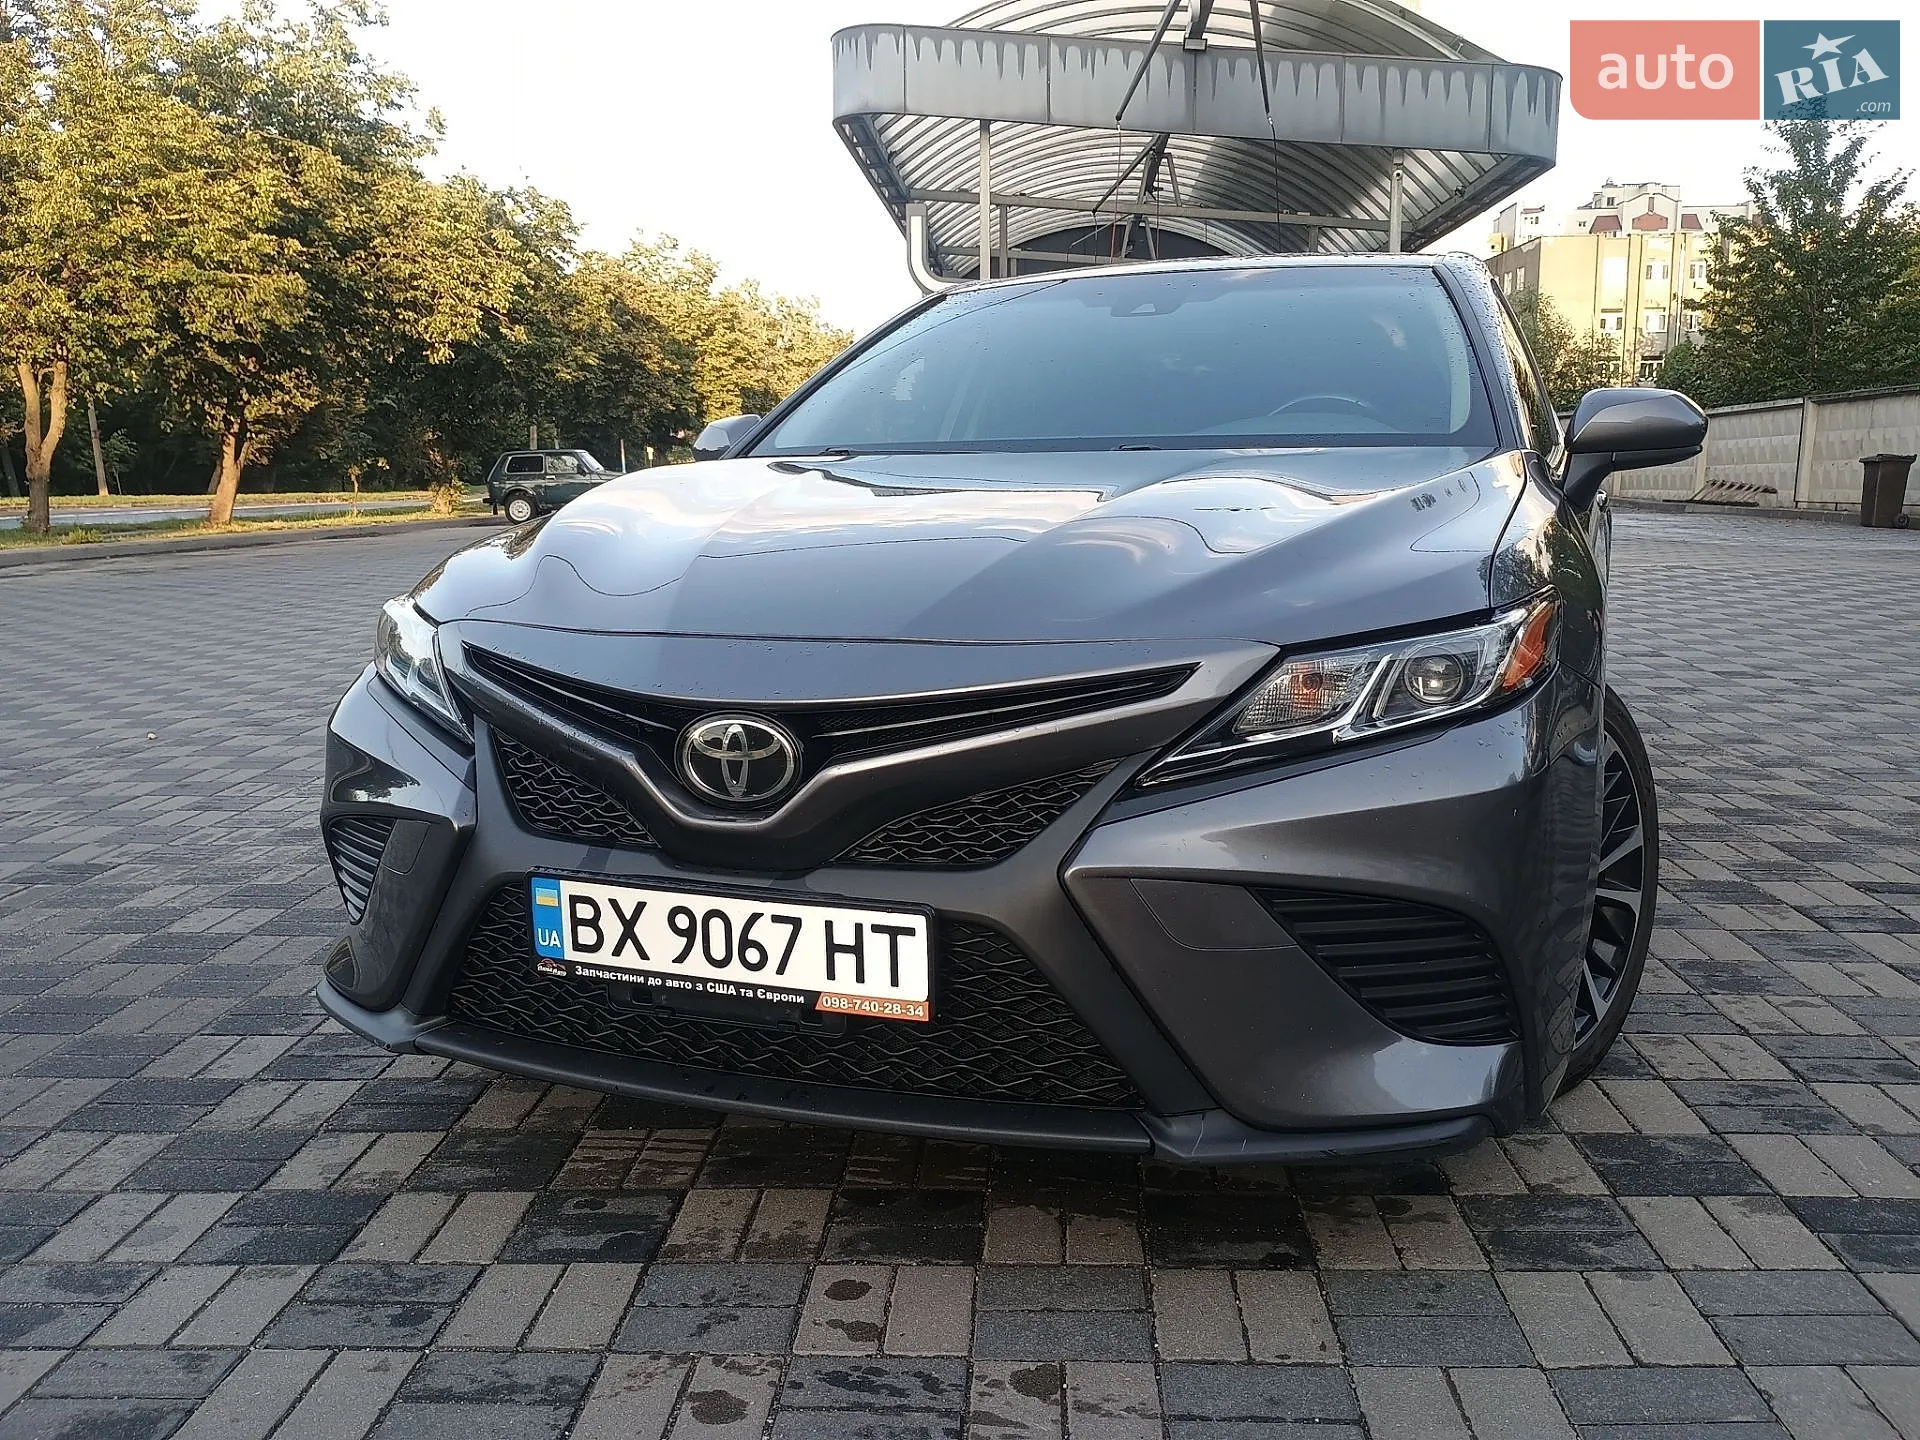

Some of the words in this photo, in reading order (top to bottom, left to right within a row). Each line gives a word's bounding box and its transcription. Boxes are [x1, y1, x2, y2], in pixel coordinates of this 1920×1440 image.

[537, 928, 562, 949] UA
[567, 894, 650, 961] BX
[666, 905, 803, 976] 9067
[824, 919, 917, 988] HT
[575, 965, 645, 984] Запчастини
[647, 977, 663, 986] до
[665, 979, 693, 990] авто
[695, 983, 703, 991] з
[706, 982, 737, 996] США
[739, 987, 754, 998] та
[757, 988, 805, 1004] Європи
[822, 995, 925, 1017] 098-740-28-34
